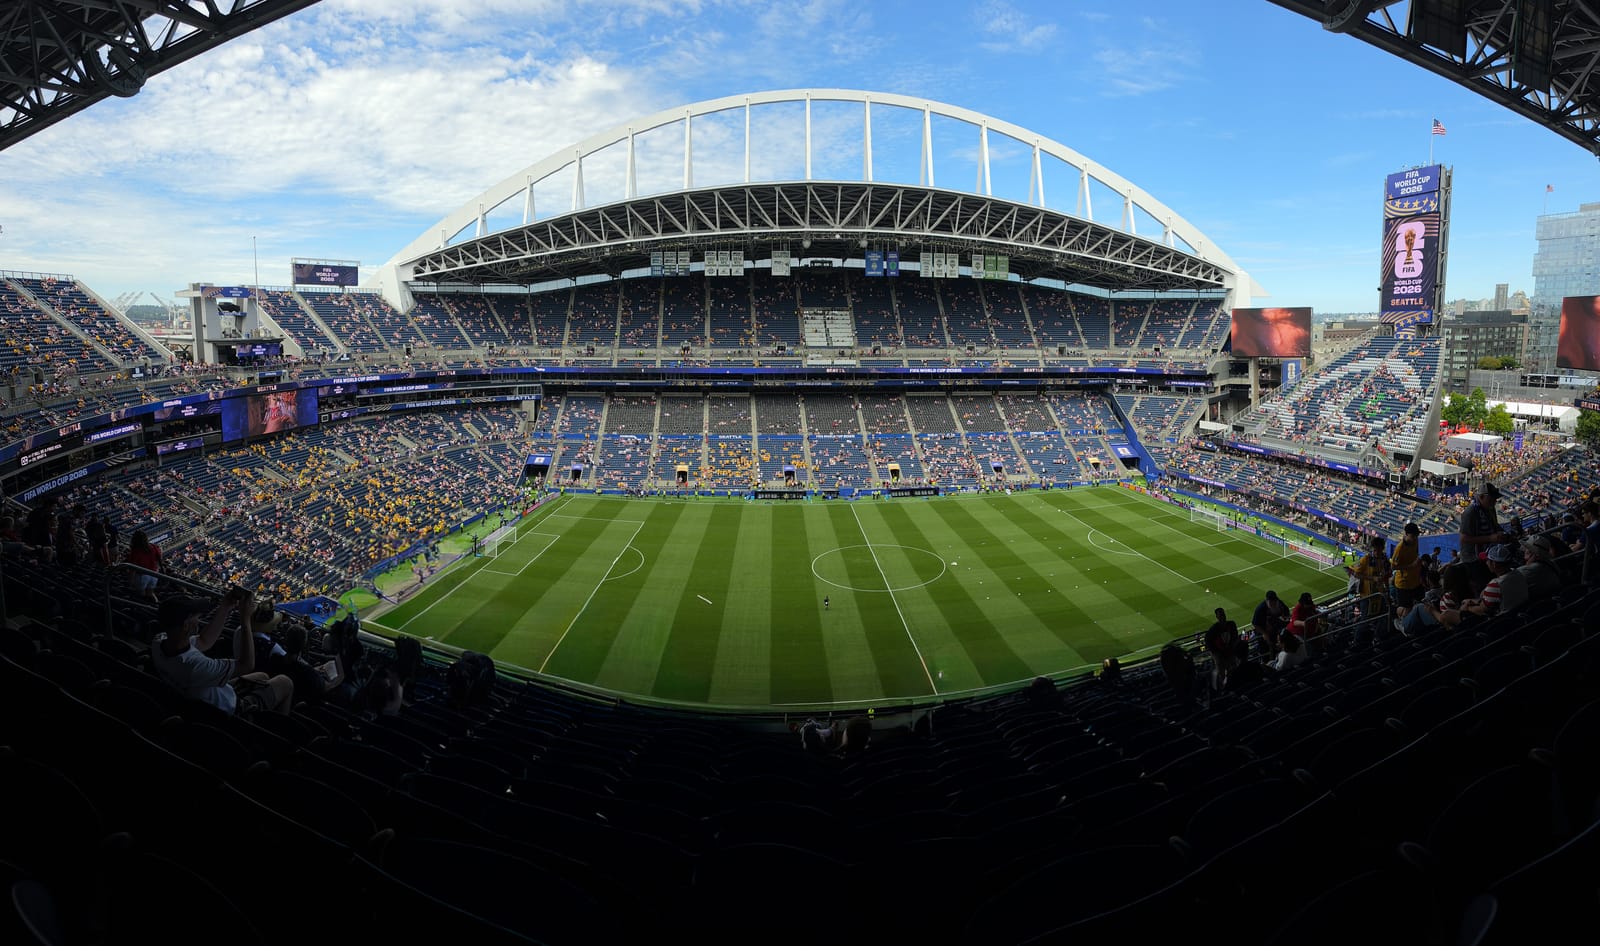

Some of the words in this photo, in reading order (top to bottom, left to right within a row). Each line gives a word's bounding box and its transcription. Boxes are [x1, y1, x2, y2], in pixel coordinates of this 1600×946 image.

[1405, 170, 1419, 179] FIFA
[1394, 179, 1417, 188] WORLD
[1417, 175, 1431, 184] CUP
[1400, 185, 1423, 195] 2026
[1393, 285, 1422, 294] 2026
[1390, 297, 1424, 306] SEATTLE
[24, 489, 37, 502] FIFA
[36, 480, 57, 495] WORLD
[57, 475, 69, 486] CUP
[69, 468, 88, 481] 2026
[1260, 531, 1285, 545] Hisense
